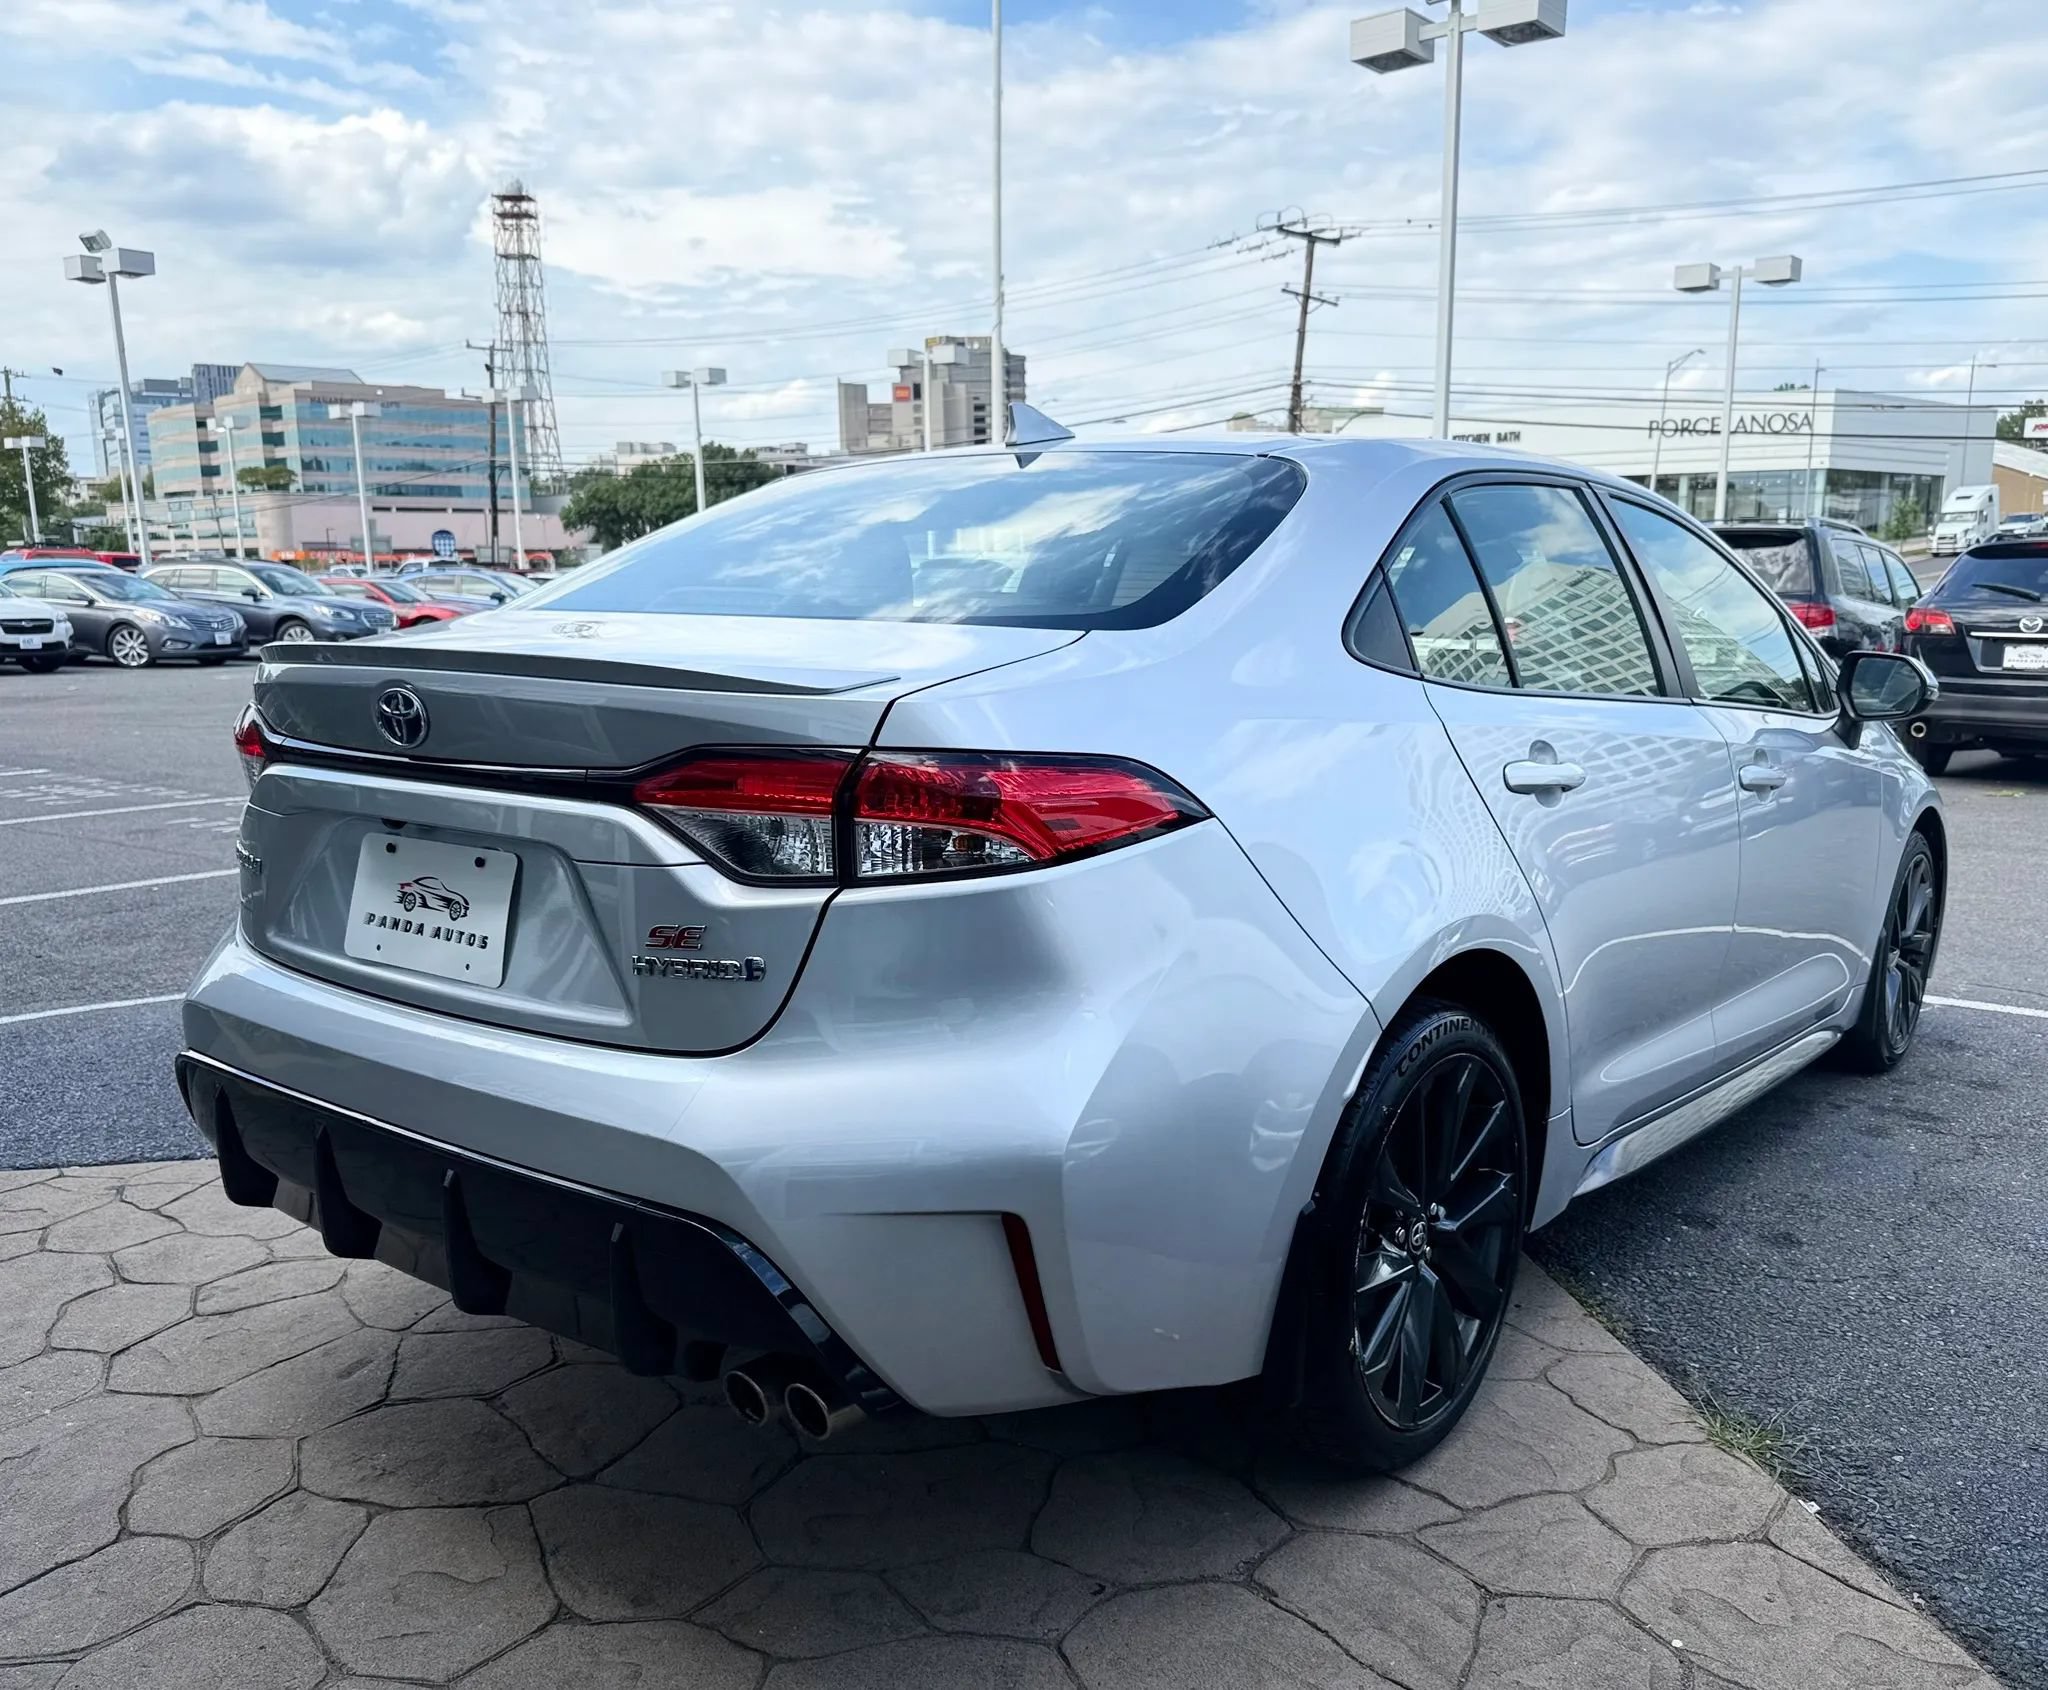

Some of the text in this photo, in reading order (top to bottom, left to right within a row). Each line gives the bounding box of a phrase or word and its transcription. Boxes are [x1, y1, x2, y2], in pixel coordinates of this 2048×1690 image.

[1496, 431, 1521, 442] BATH
[1648, 413, 1813, 439] PORCEANOSA
[363, 911, 489, 950] PANDA AUTOS
[645, 924, 707, 951] SE
[631, 955, 743, 980] HYBRID
